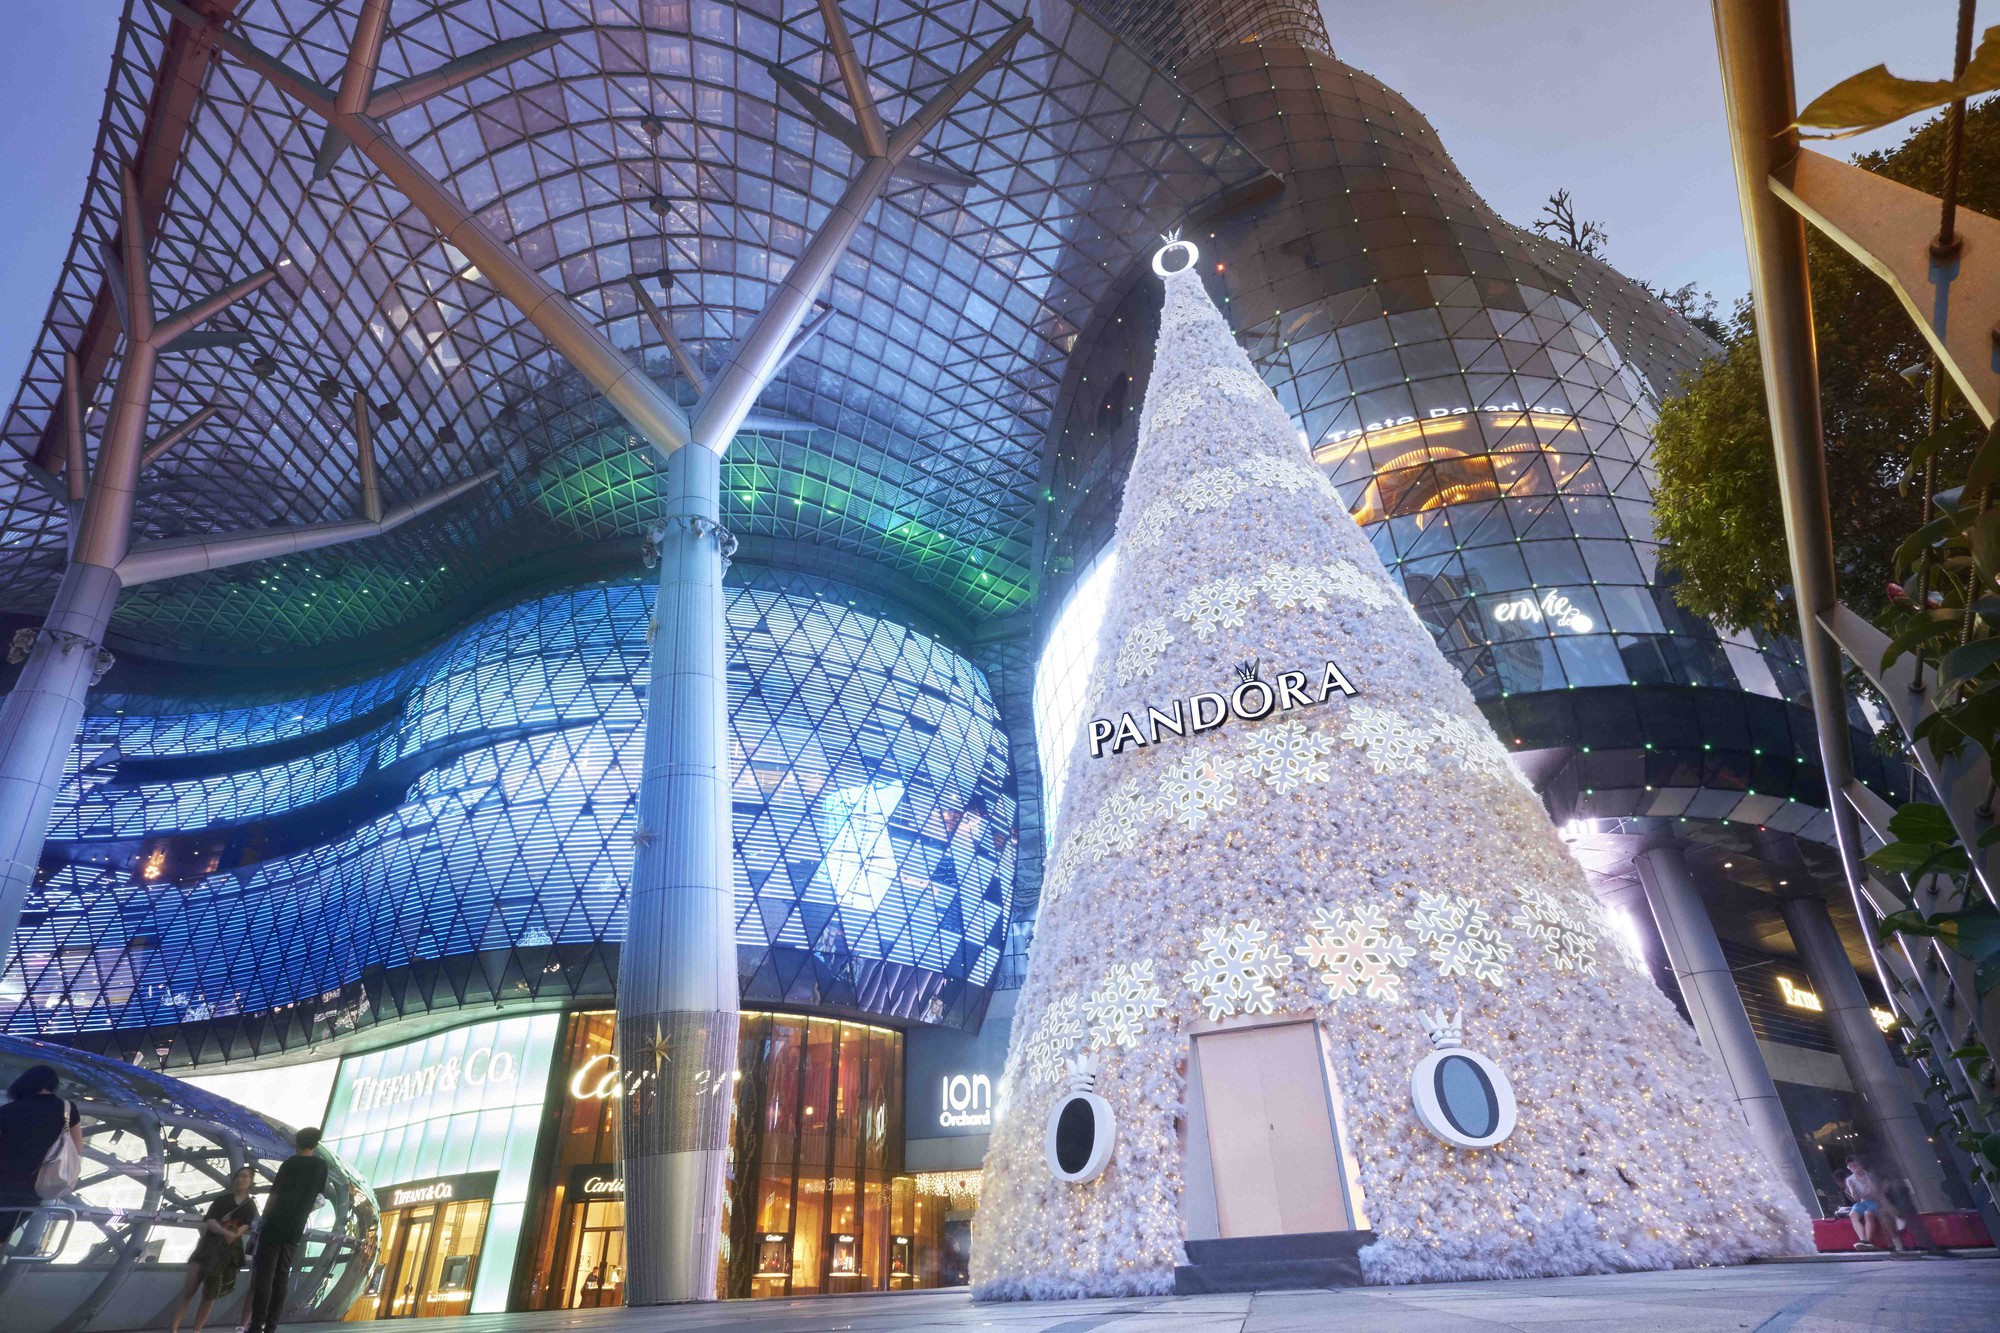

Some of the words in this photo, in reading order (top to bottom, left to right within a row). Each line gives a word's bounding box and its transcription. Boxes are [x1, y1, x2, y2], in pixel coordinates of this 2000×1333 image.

[1326, 416, 1415, 443] Taste
[1087, 660, 1359, 759] PANDORA
[350, 1063, 443, 1114] TIFFANY
[439, 1056, 462, 1092] &
[571, 1053, 741, 1099] Carer
[939, 1109, 991, 1127] Orchard
[393, 1189, 429, 1206] TIFFANY
[584, 1176, 625, 1193] Cartie
